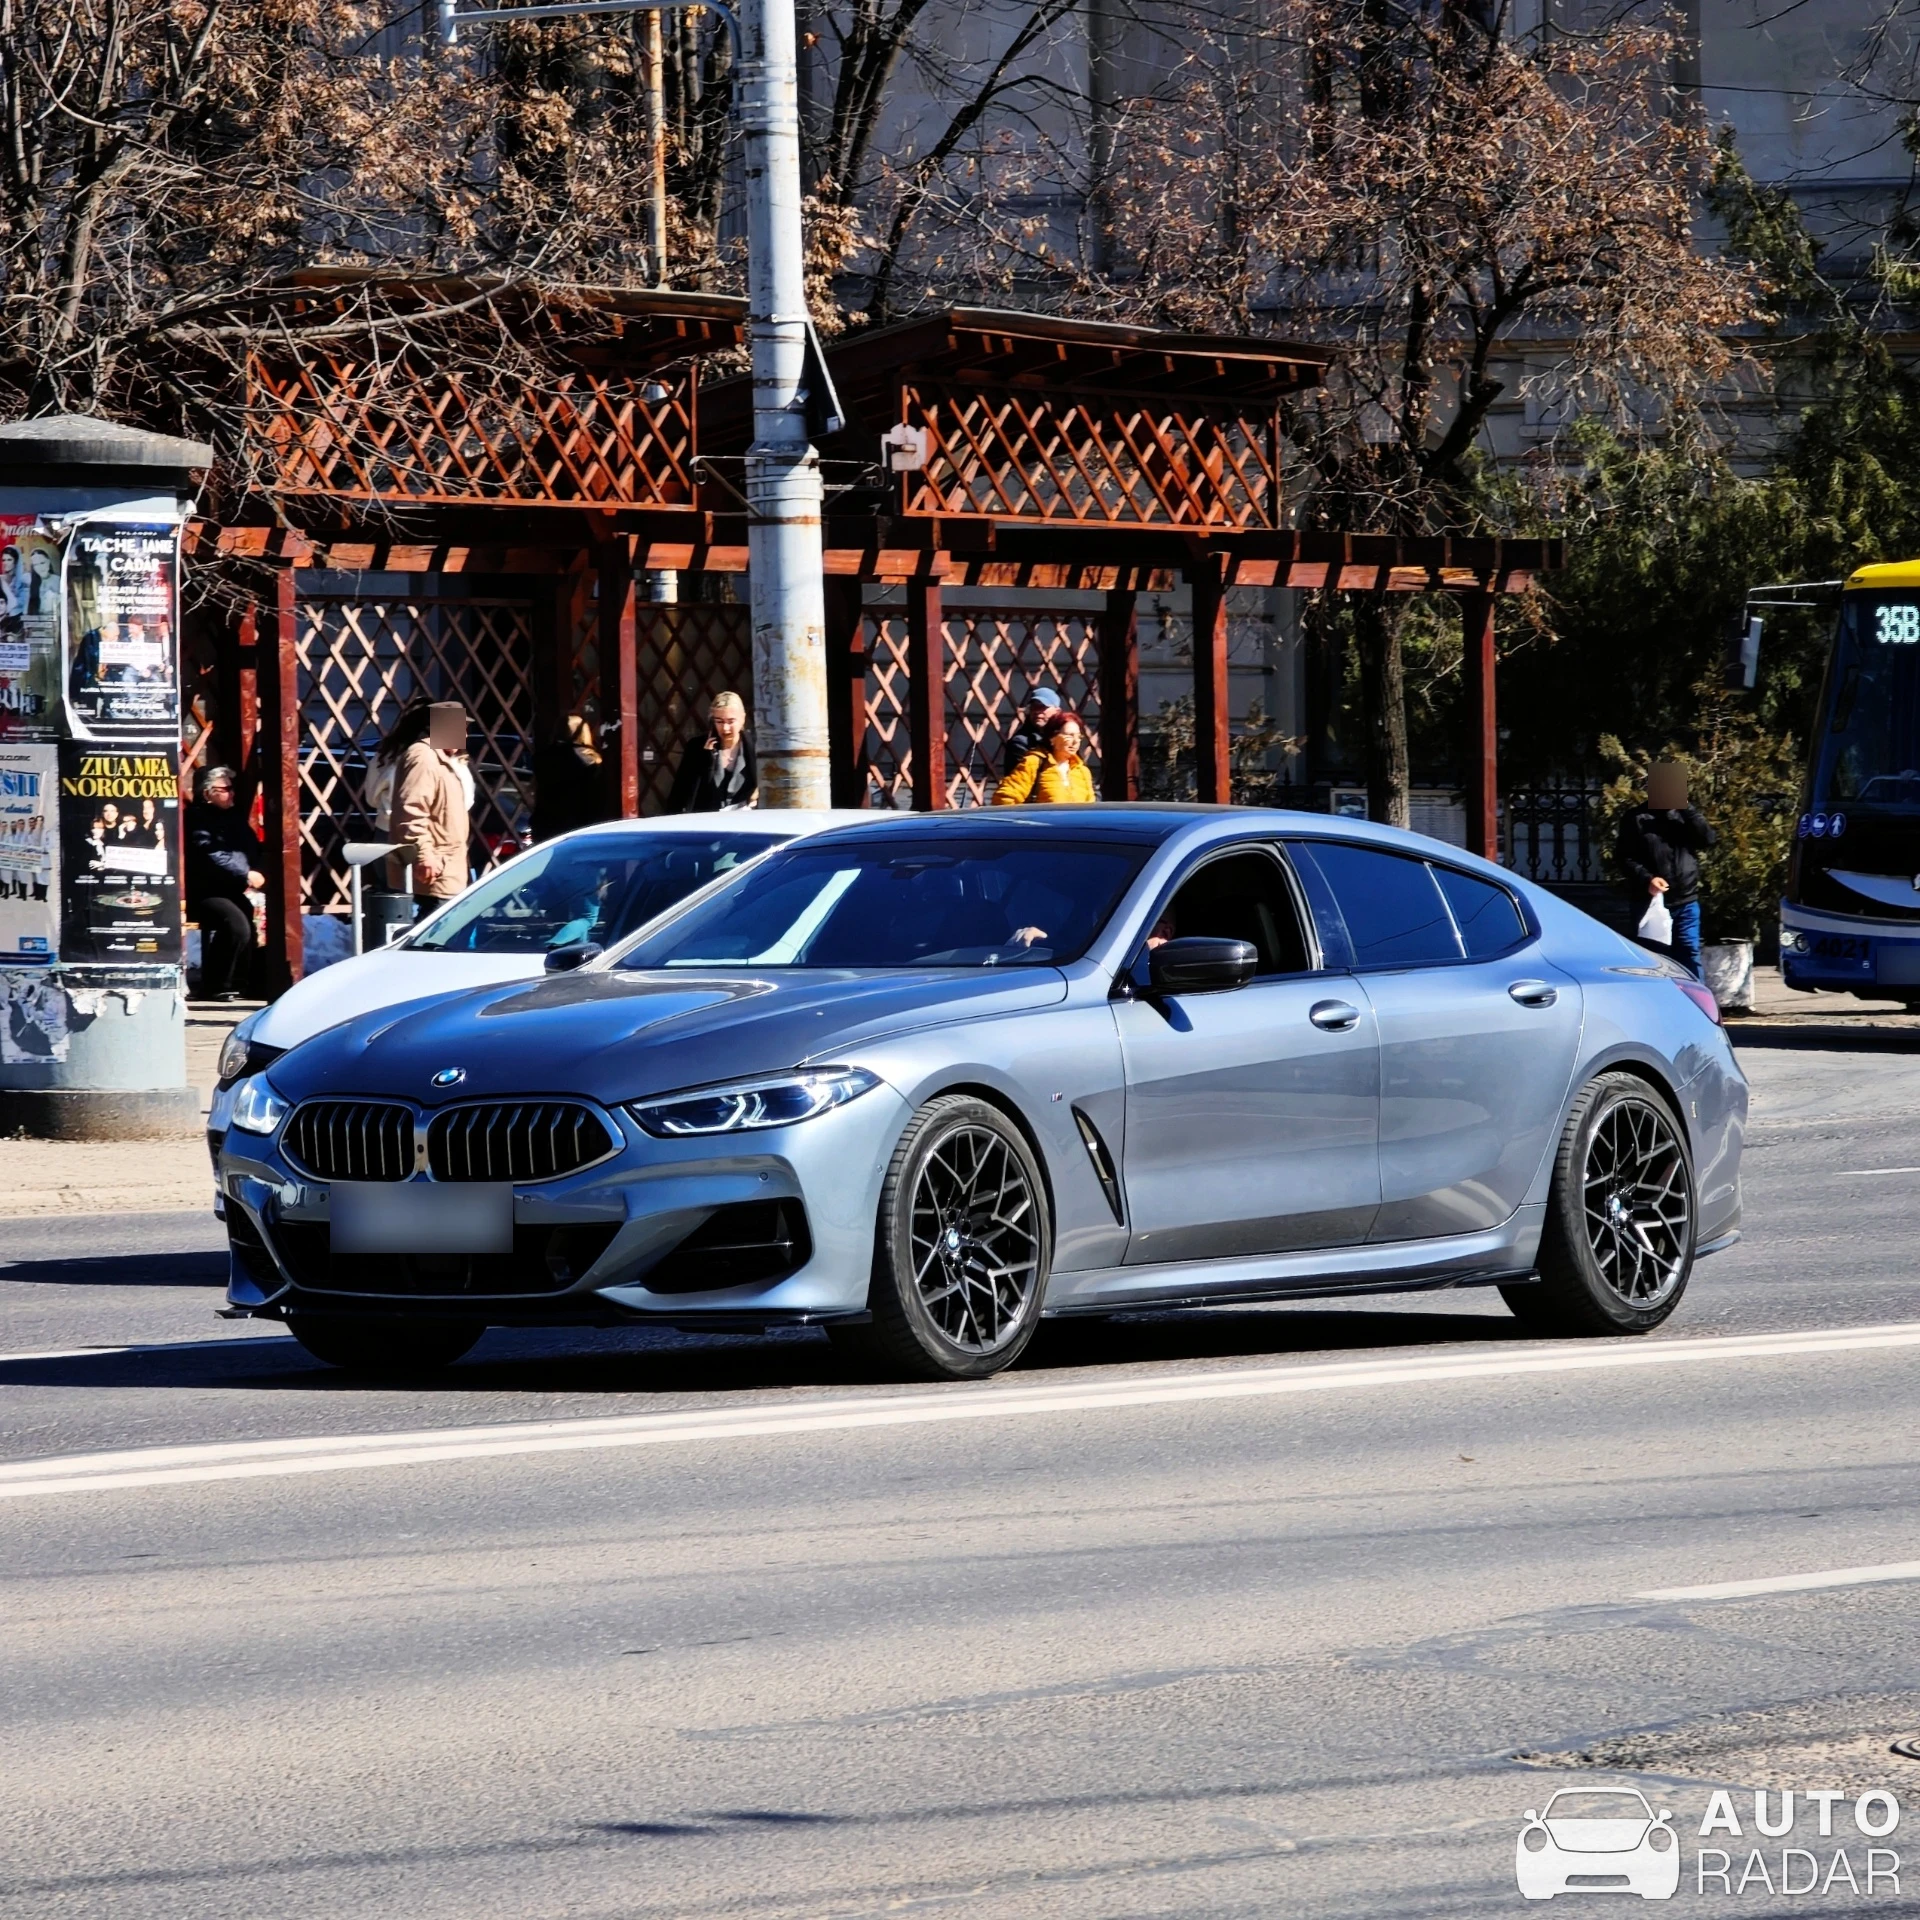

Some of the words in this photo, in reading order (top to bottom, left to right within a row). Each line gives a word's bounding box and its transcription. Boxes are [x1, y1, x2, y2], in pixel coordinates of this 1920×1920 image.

[1875, 605, 1920, 644] 35B
[80, 756, 132, 778] ZIUA
[133, 757, 170, 777] MEA
[61, 775, 178, 798] NOROCOASĂ
[1814, 937, 1870, 959] 4021
